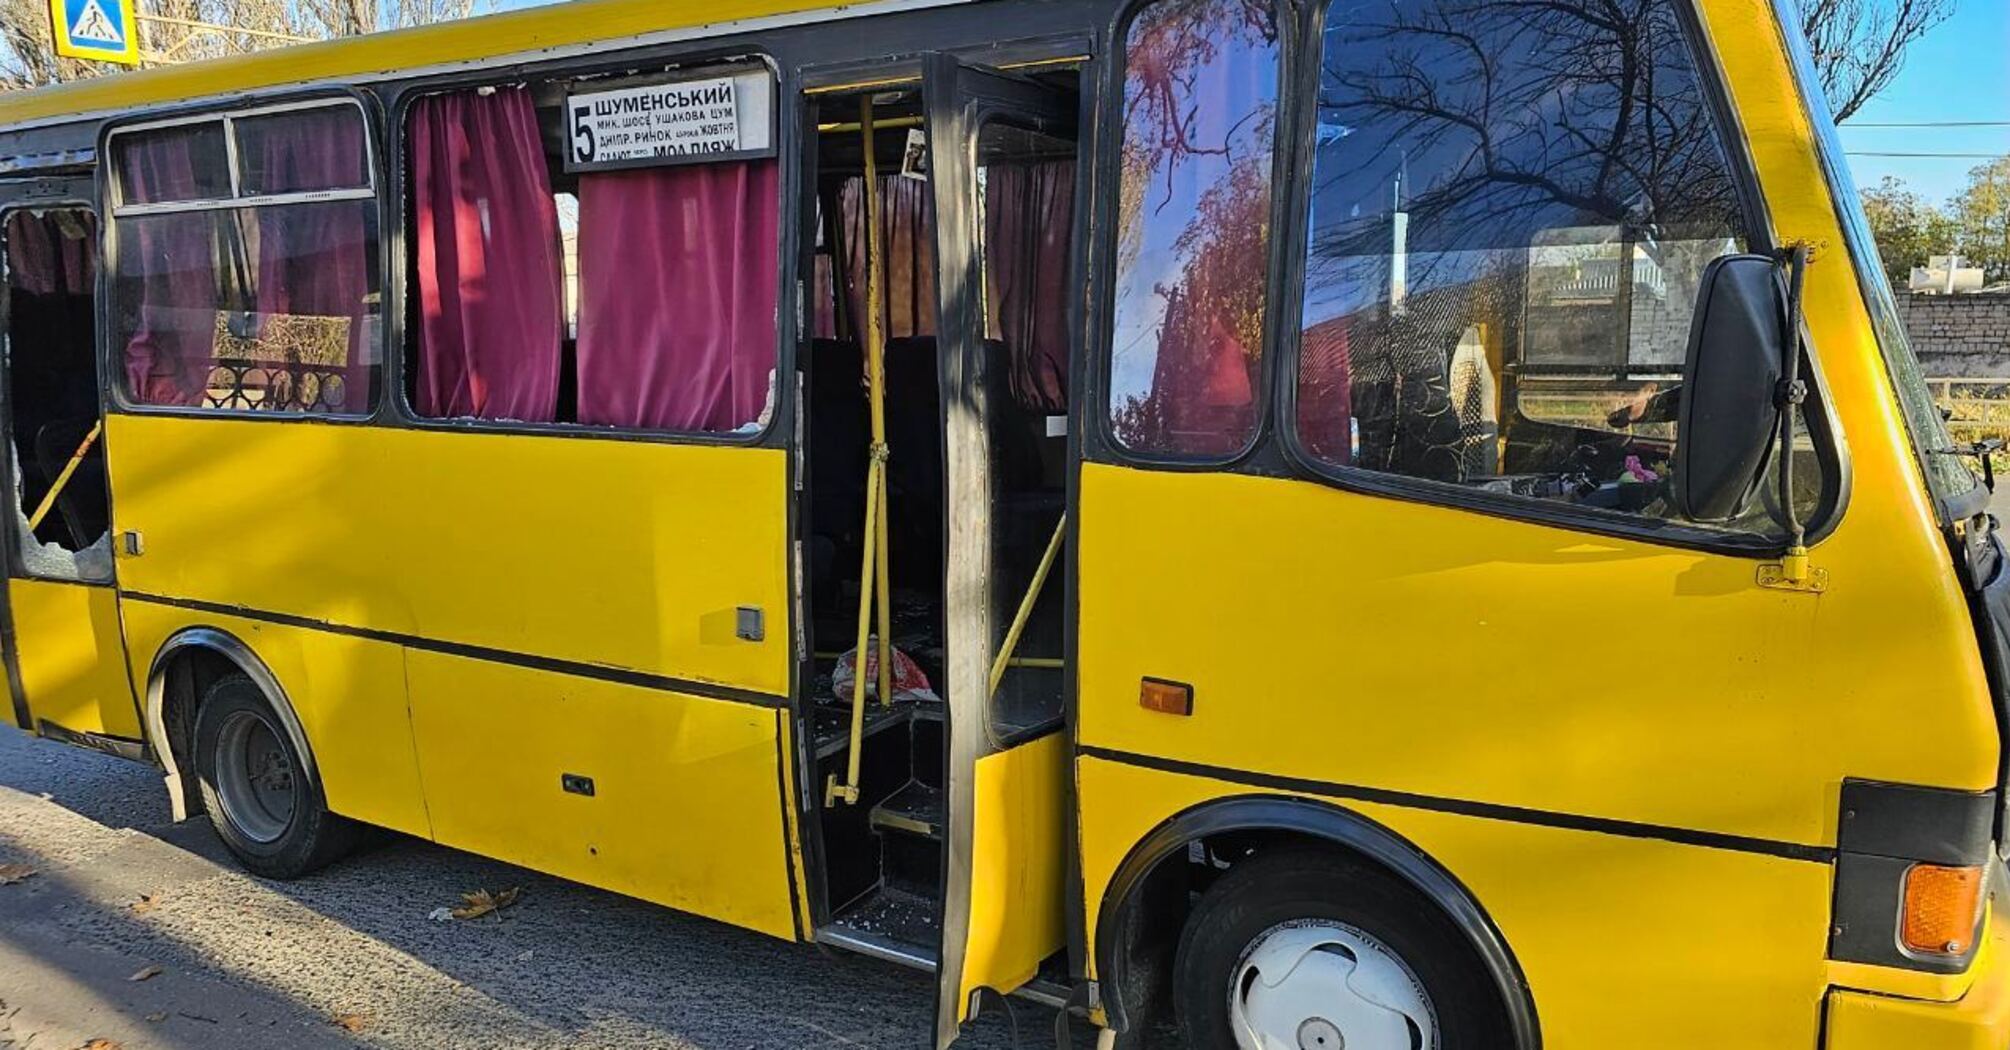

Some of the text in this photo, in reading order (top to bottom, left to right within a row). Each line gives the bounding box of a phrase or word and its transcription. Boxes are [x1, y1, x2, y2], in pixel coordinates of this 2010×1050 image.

[595, 81, 732, 116] ШУМЕНСЬКИЙ
[622, 115, 651, 128] ШОСЕ
[655, 110, 706, 124] УШАКОВА
[710, 107, 734, 120] ЦУМ
[574, 106, 595, 162] 5
[634, 129, 672, 144] РИНОК
